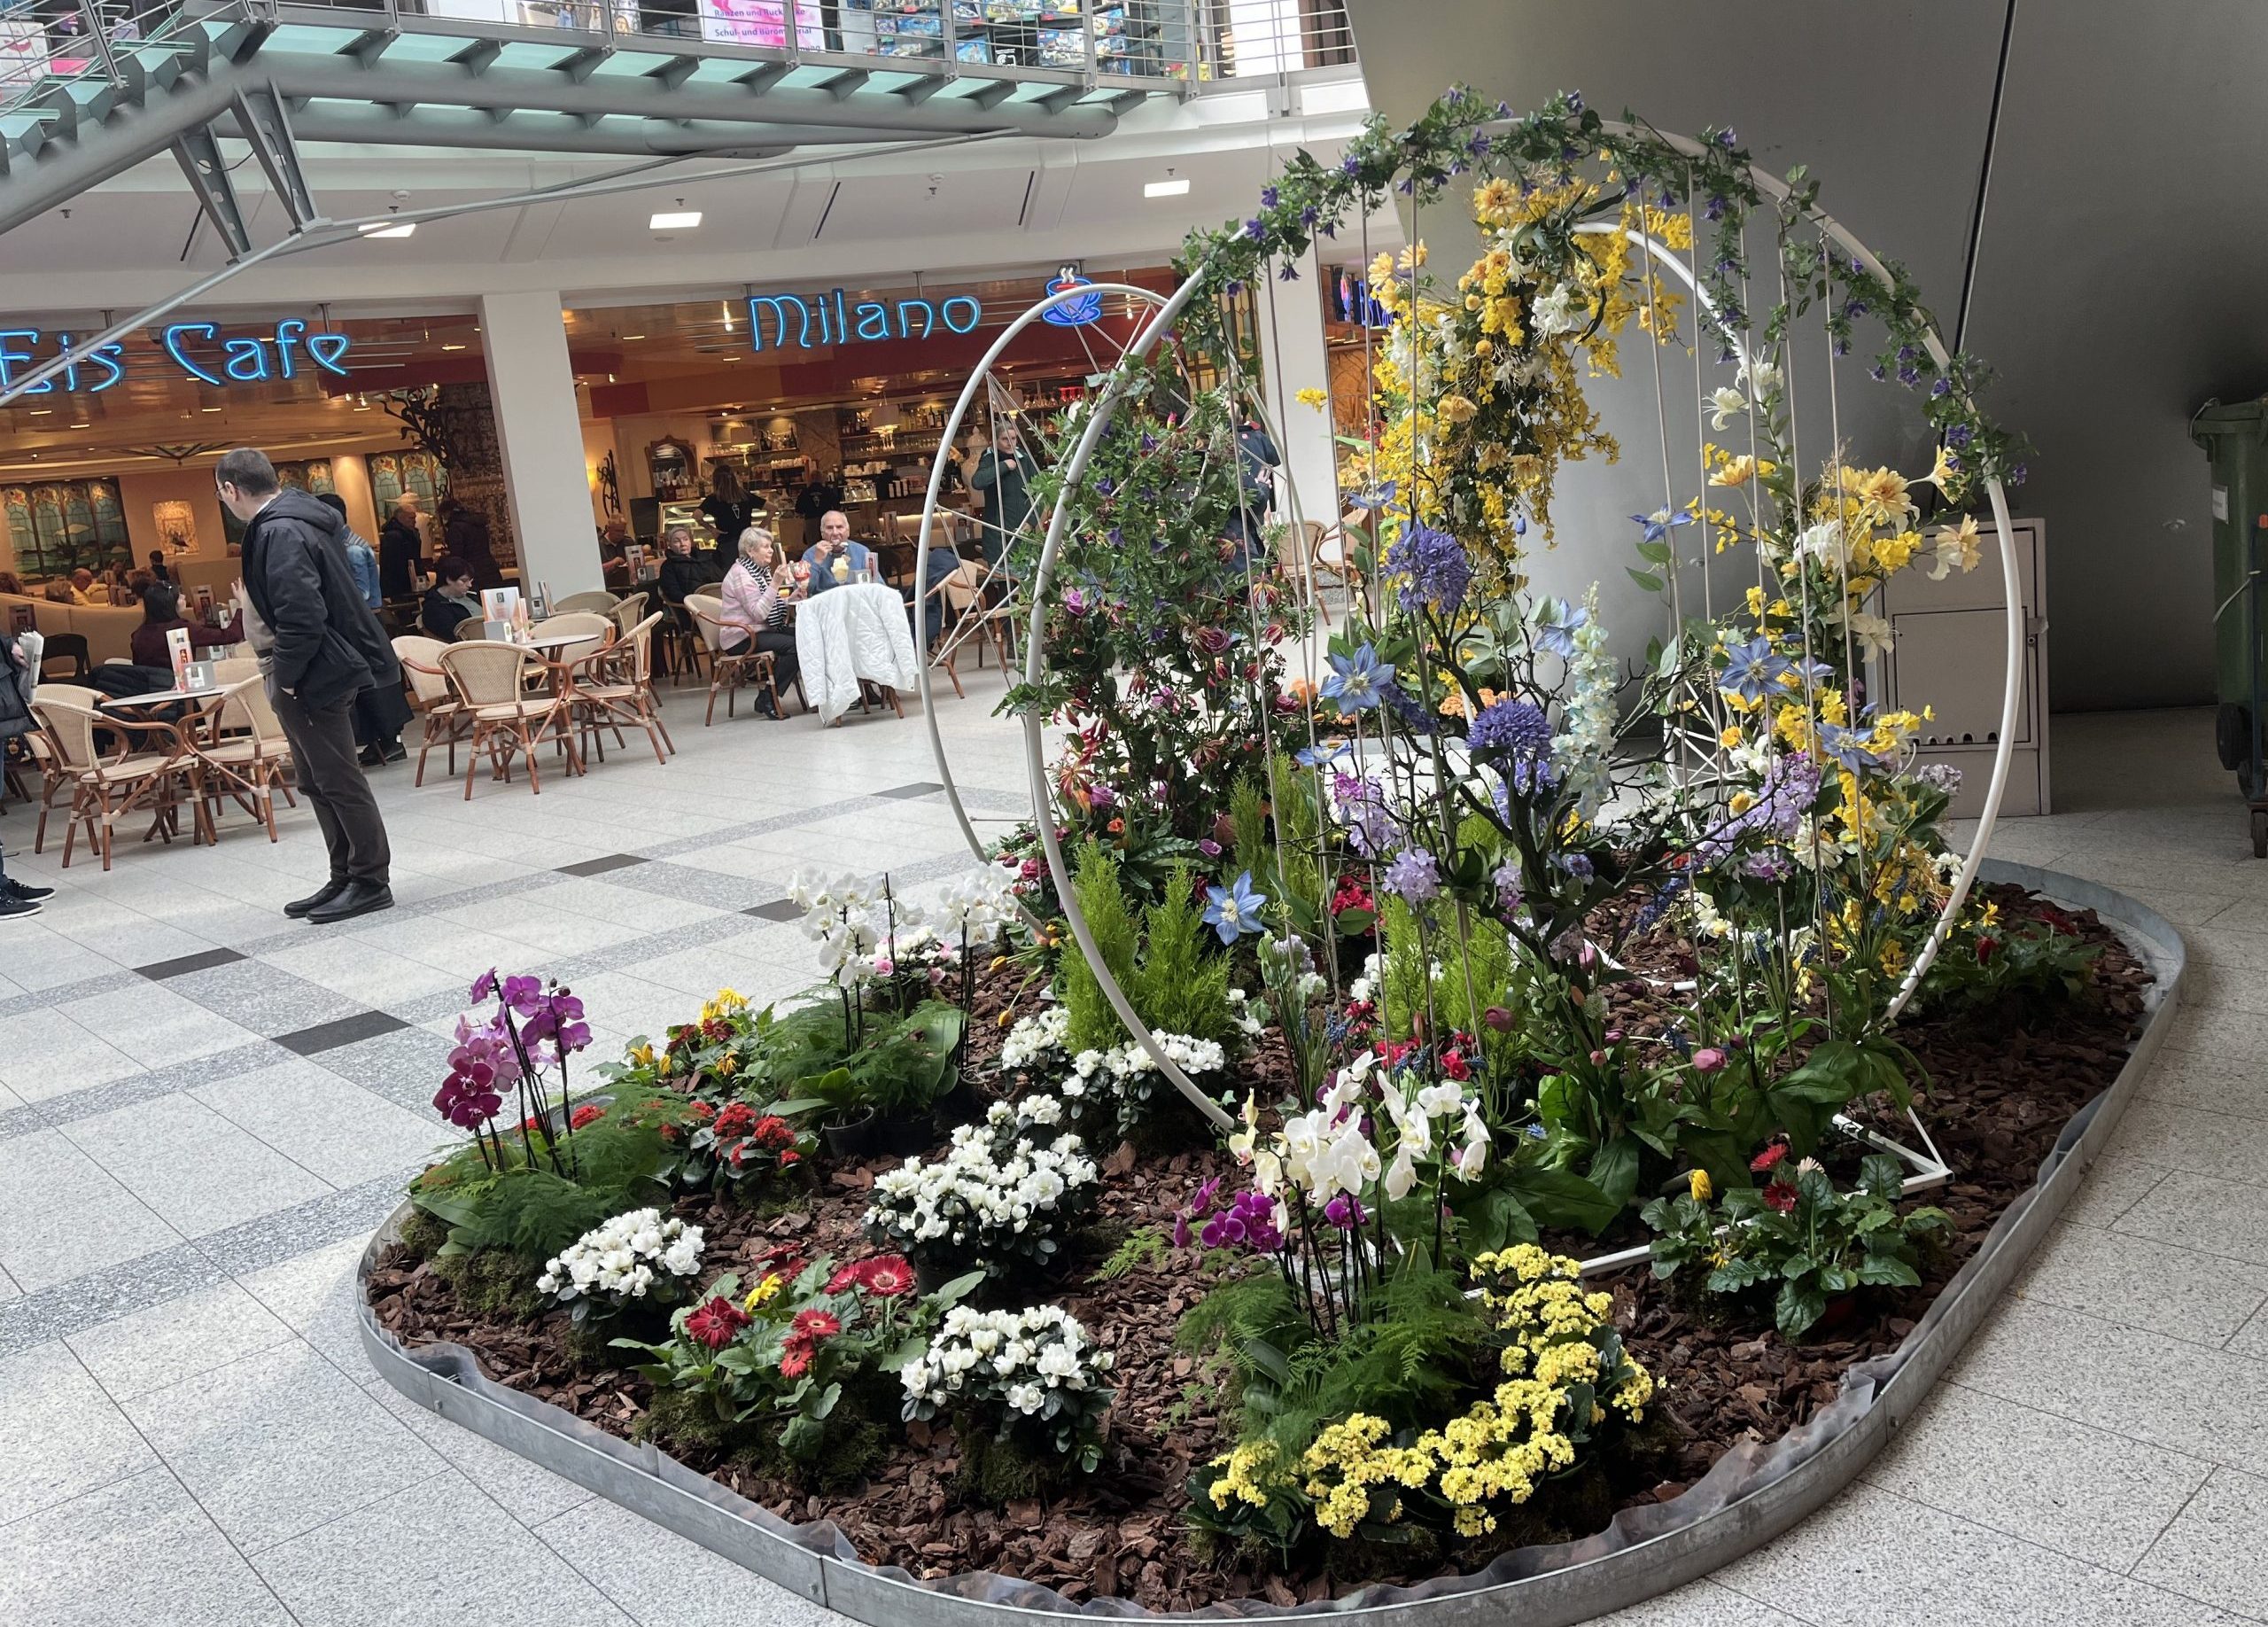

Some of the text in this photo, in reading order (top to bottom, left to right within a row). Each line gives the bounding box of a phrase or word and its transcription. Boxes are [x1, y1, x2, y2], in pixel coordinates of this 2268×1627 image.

[715, 27, 812, 37] Schul- und Büromerial
[747, 289, 982, 351] Milano
[0, 317, 352, 393] Eis Cafe
